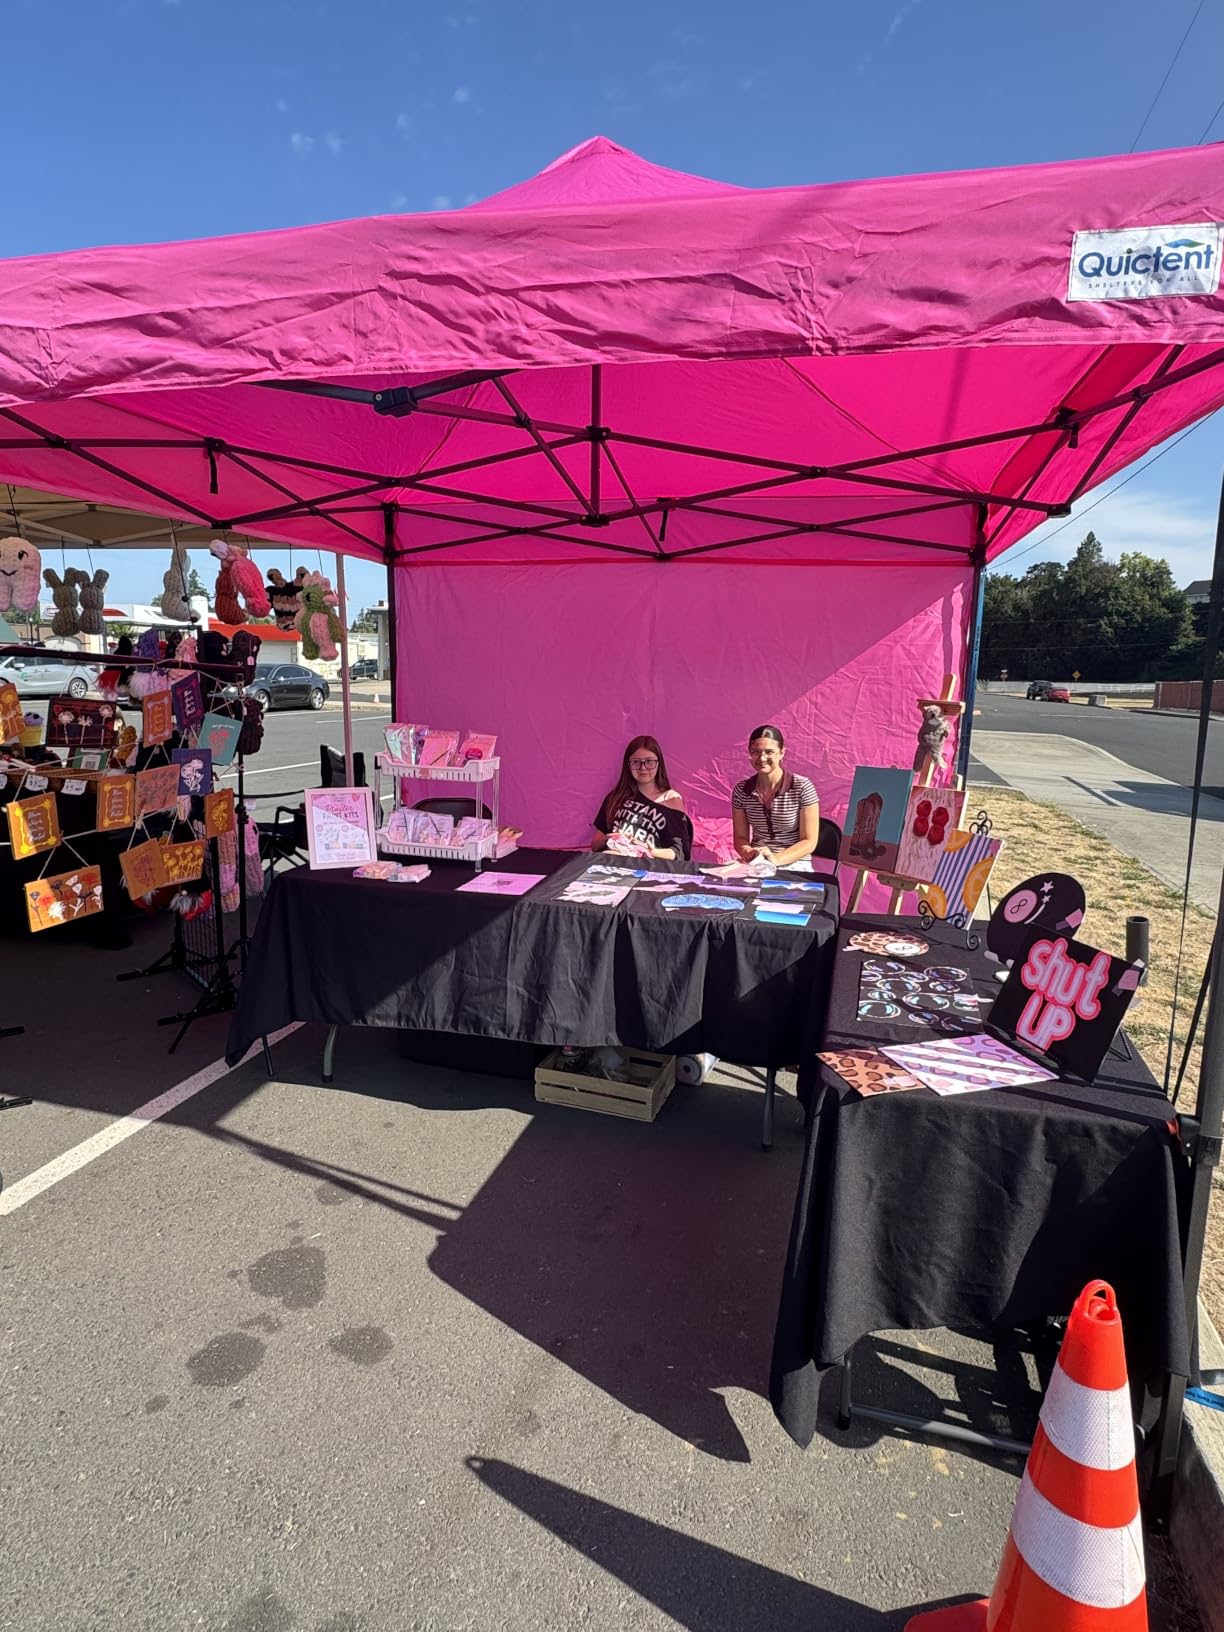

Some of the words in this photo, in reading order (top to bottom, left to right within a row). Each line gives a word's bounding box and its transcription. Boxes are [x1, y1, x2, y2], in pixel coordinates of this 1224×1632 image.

[1078, 244, 1214, 278] Quictent
[1088, 279, 1143, 289] SHELTERS
[322, 812, 342, 820] PAINT
[344, 811, 360, 819] KITS
[623, 800, 666, 830] STAND
